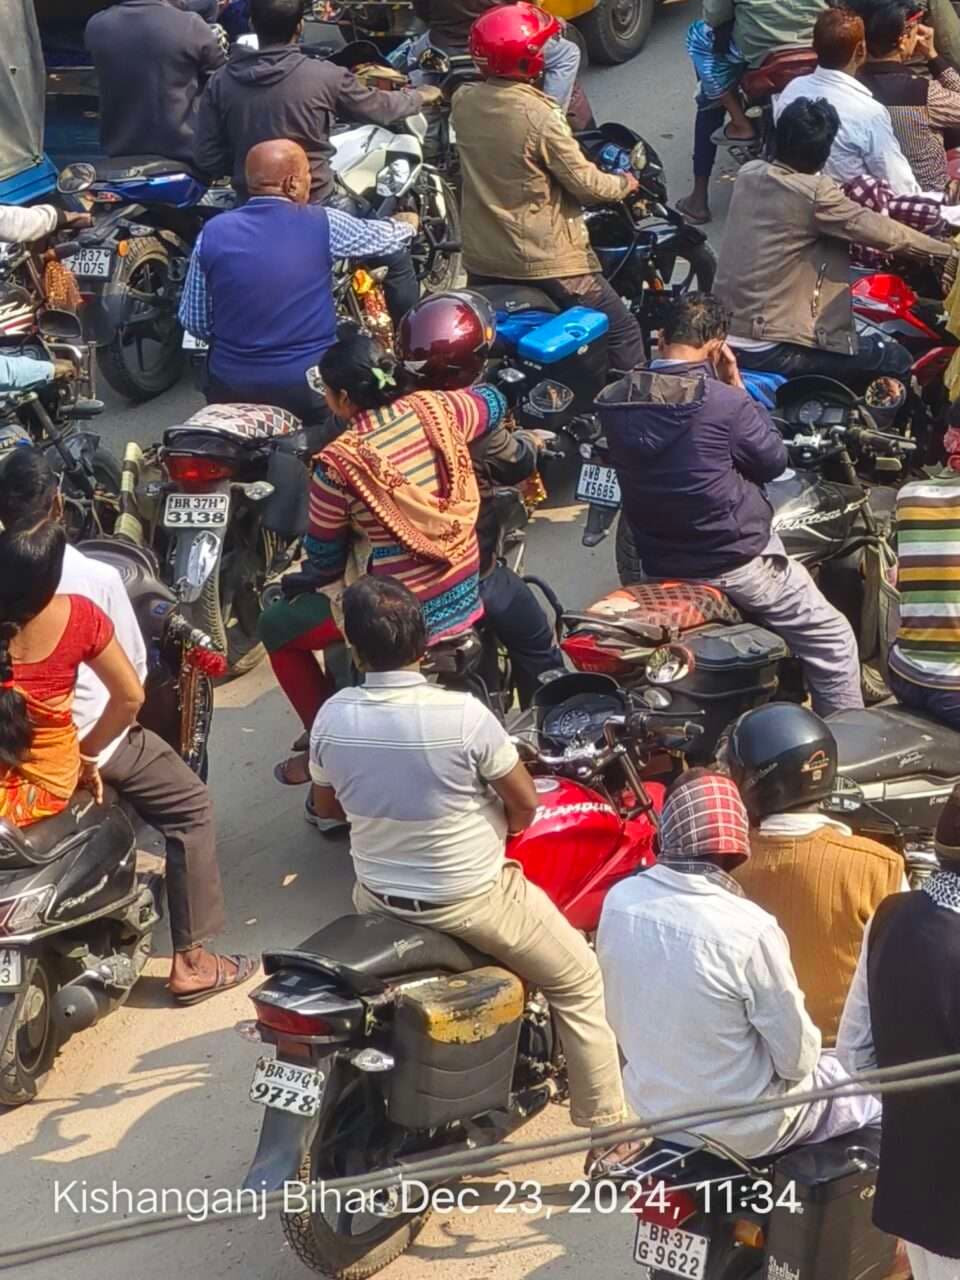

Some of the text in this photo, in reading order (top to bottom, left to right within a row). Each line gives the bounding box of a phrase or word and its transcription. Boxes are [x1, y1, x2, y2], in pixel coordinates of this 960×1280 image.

[70, 261, 105, 274] Z1075
[174, 497, 219, 510] BR 37H
[166, 511, 226, 524] 3138
[254, 1082, 317, 1114] 9778
